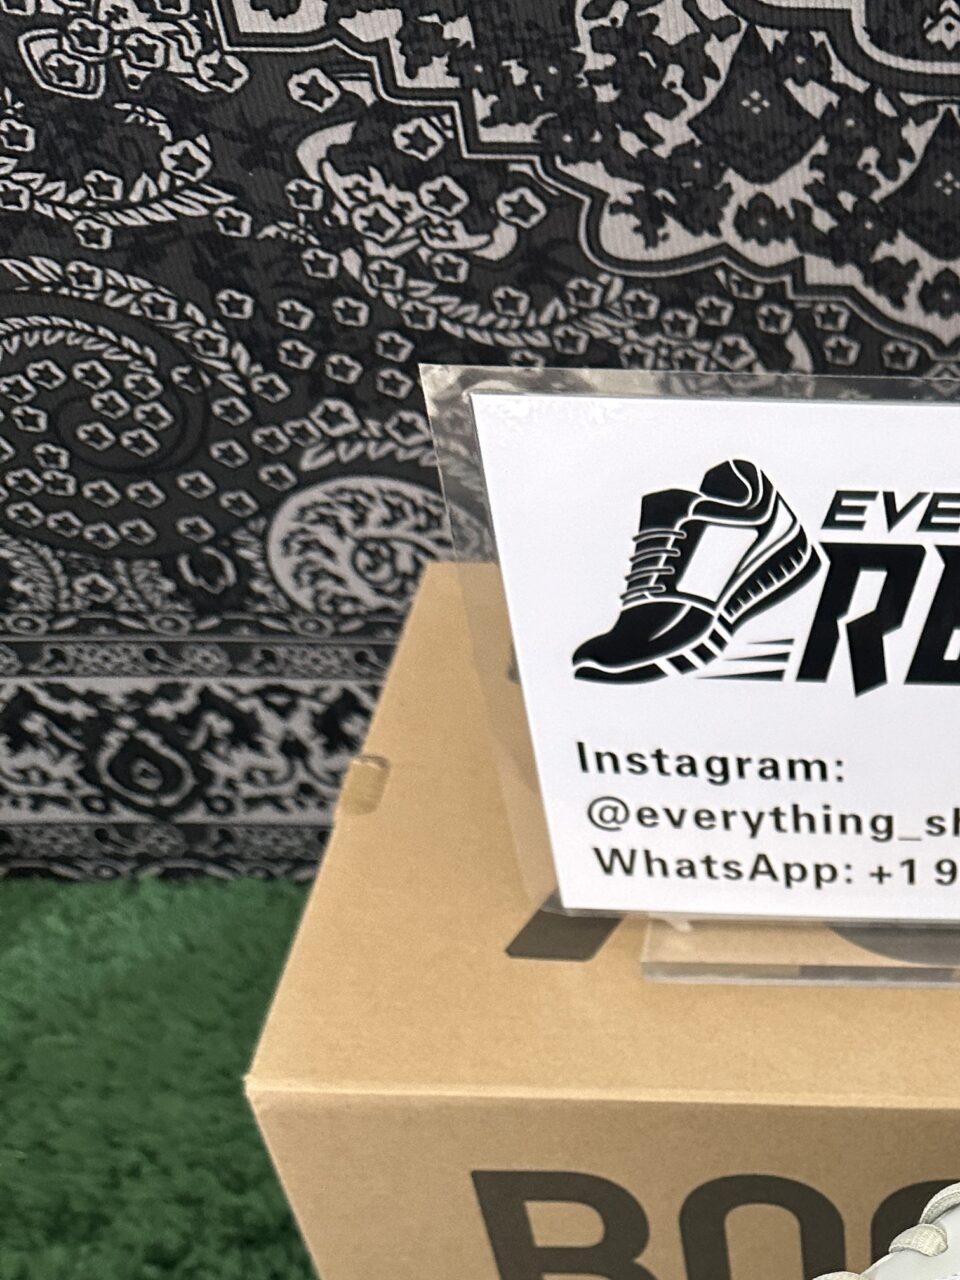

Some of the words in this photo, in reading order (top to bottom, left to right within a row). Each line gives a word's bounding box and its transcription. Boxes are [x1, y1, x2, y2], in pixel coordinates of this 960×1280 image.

[576, 741, 845, 786] Instagram:
[593, 846, 855, 889] WhatsApp:
[869, 858, 916, 886] +1
